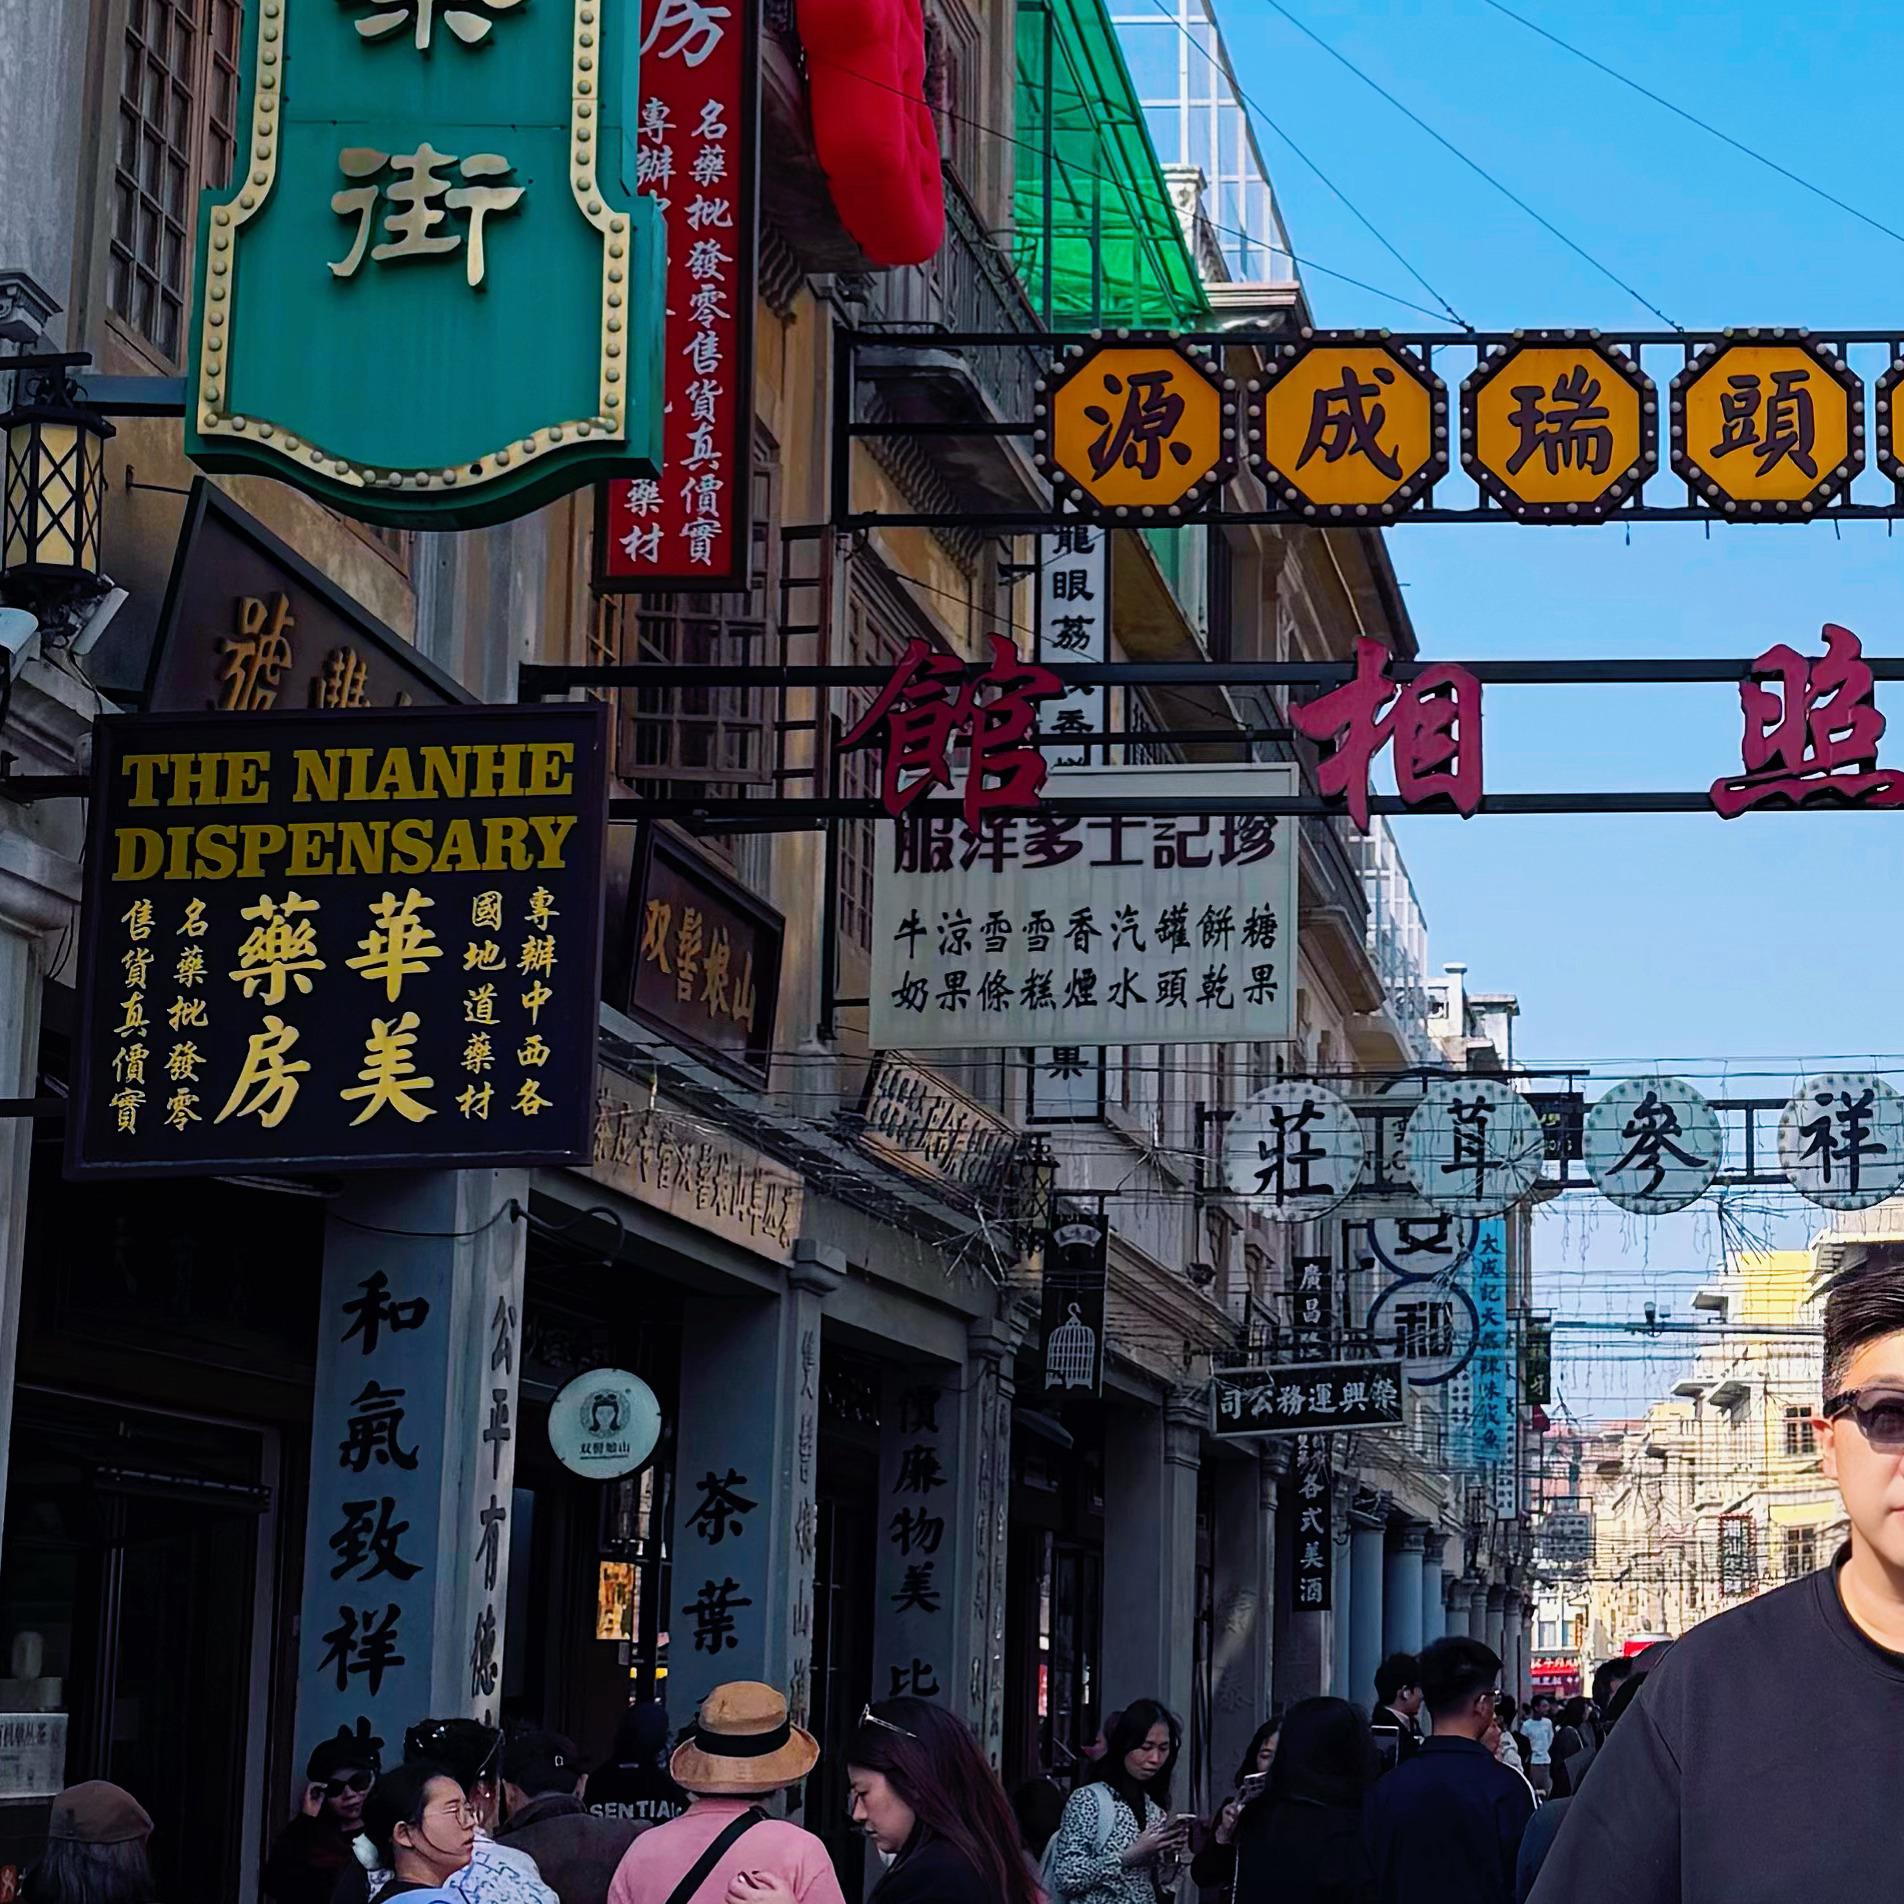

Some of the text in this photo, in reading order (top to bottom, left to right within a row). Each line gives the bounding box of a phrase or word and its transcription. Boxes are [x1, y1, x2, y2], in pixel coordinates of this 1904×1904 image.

[111, 815, 578, 882] DISPENSARY
[121, 742, 575, 808] THE NIANHE
[316, 1270, 430, 1746] 和氣致祥
[469, 1294, 520, 1724] 公平有德
